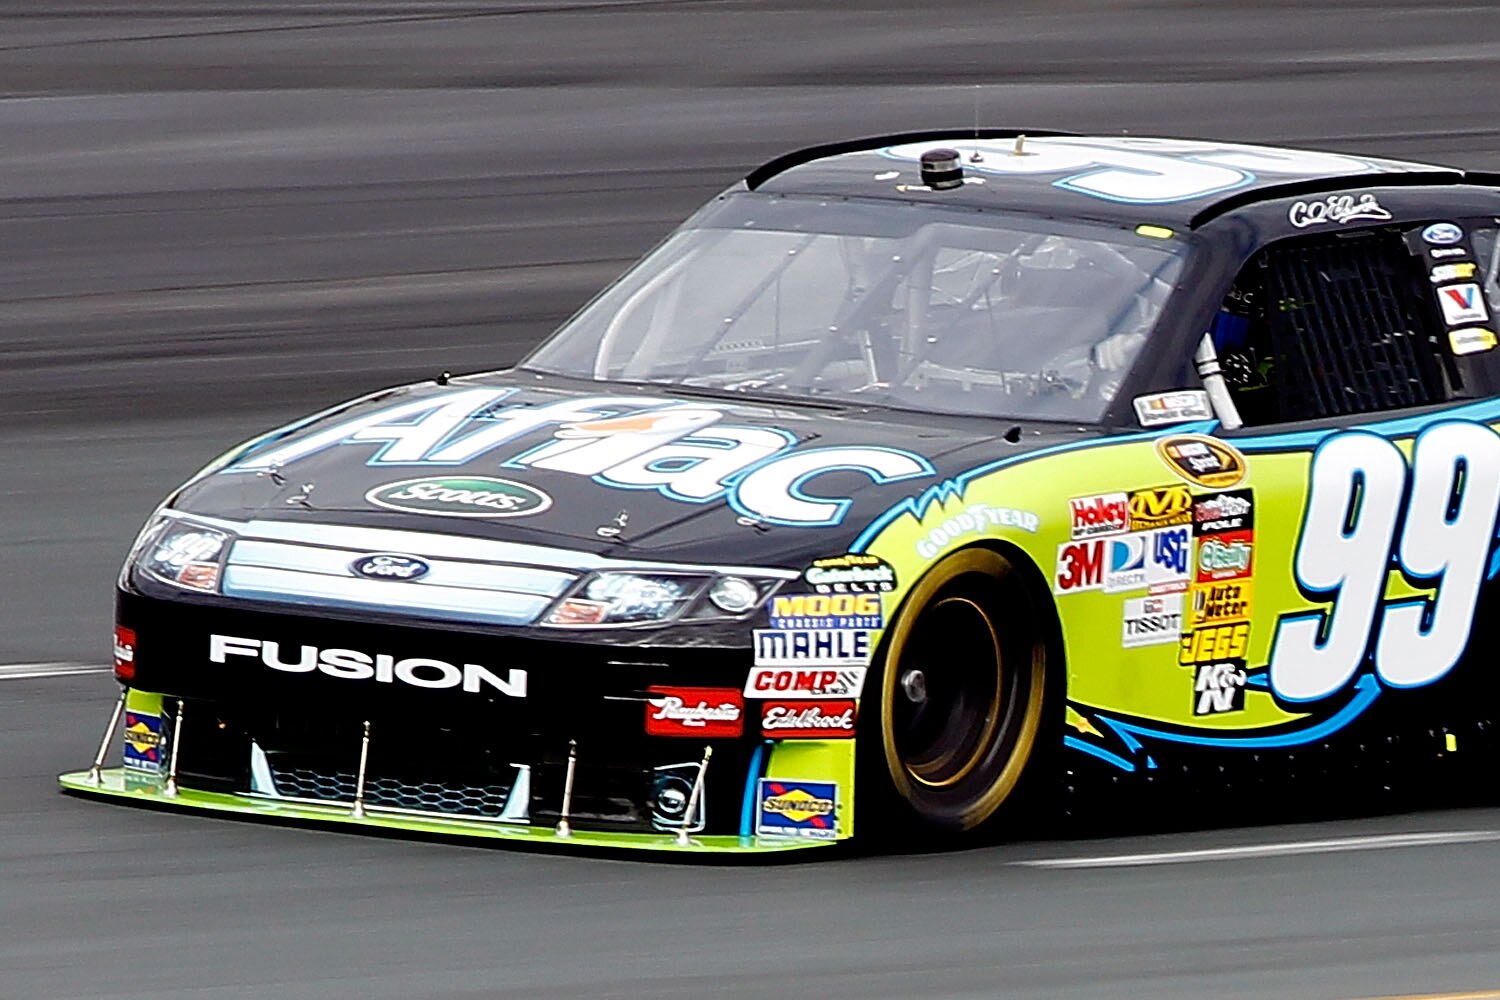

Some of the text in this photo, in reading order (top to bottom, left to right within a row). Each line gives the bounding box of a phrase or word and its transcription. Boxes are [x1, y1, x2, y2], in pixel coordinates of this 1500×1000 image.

[224, 388, 936, 526] Aflac
[1072, 497, 1127, 528] Holley
[916, 504, 1039, 559] GOODYEAR
[1154, 528, 1189, 574] USG
[362, 555, 424, 577] Ford
[1058, 540, 1105, 590] 3M
[771, 594, 880, 617] MOOG
[1208, 585, 1241, 601] Auto
[1206, 600, 1247, 617] Meter
[1124, 614, 1181, 635] TISSOT
[758, 631, 868, 659] MAHLE
[1181, 624, 1249, 664] JEGS
[208, 633, 528, 698] FUSION
[754, 671, 838, 691] COMP
[761, 706, 854, 730] Edelbrock
[763, 798, 834, 814] SUNOCO
